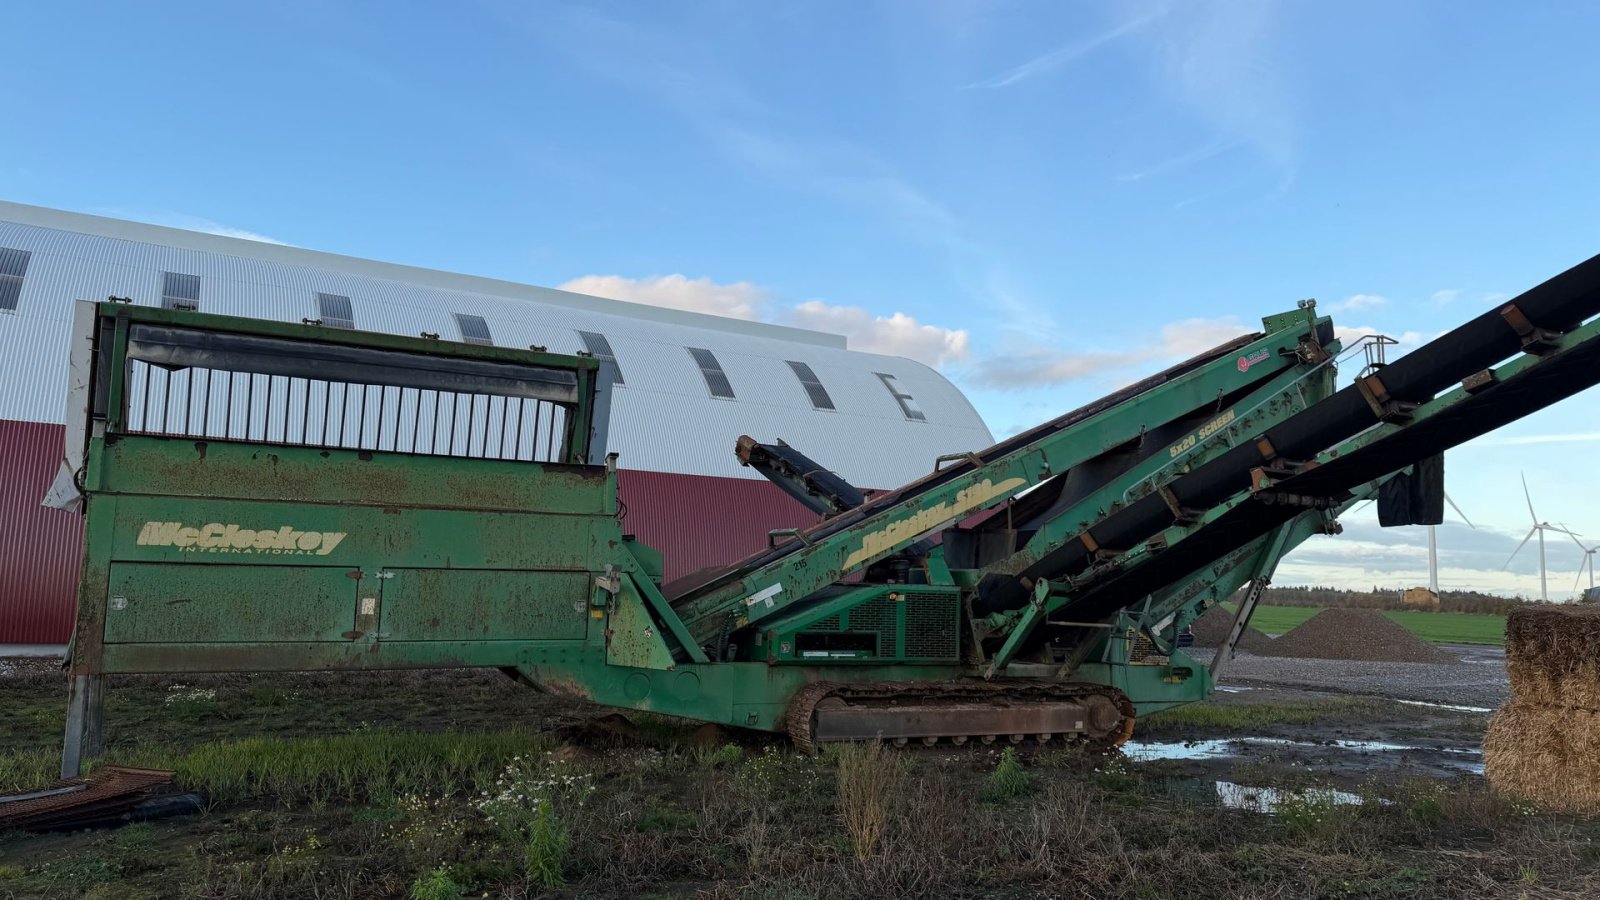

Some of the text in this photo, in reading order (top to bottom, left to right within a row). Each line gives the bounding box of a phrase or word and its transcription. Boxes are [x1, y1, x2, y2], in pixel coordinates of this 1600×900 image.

[1199, 409, 1235, 439] SCREEN
[136, 521, 347, 556] McCloskey
[178, 546, 318, 556] INTERNATIONAL
[792, 558, 808, 571] 215
